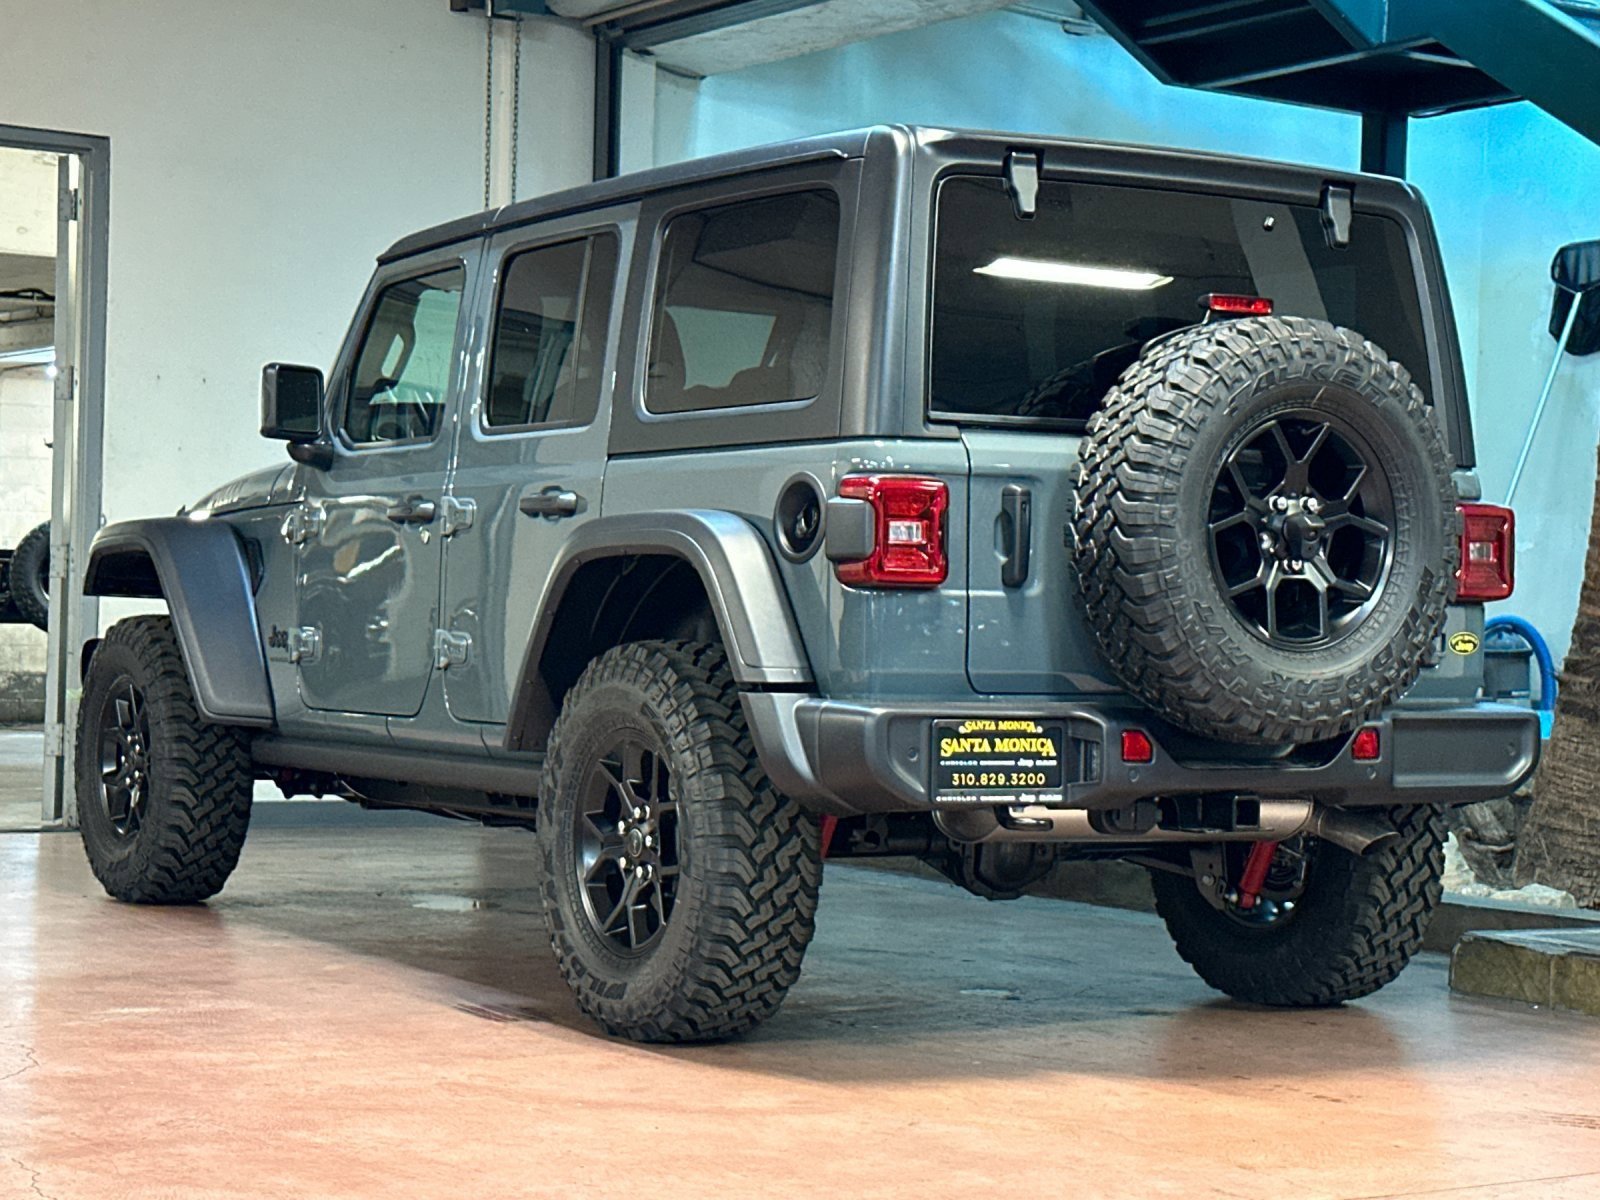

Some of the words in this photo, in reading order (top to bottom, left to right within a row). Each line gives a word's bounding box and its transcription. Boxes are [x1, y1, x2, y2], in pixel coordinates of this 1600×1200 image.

[964, 720, 997, 733] SANTA
[998, 721, 1037, 733] MONICA
[940, 738, 991, 757] SANTA
[994, 738, 1057, 757] MONICA
[952, 773, 1046, 785] 310.829.3200
